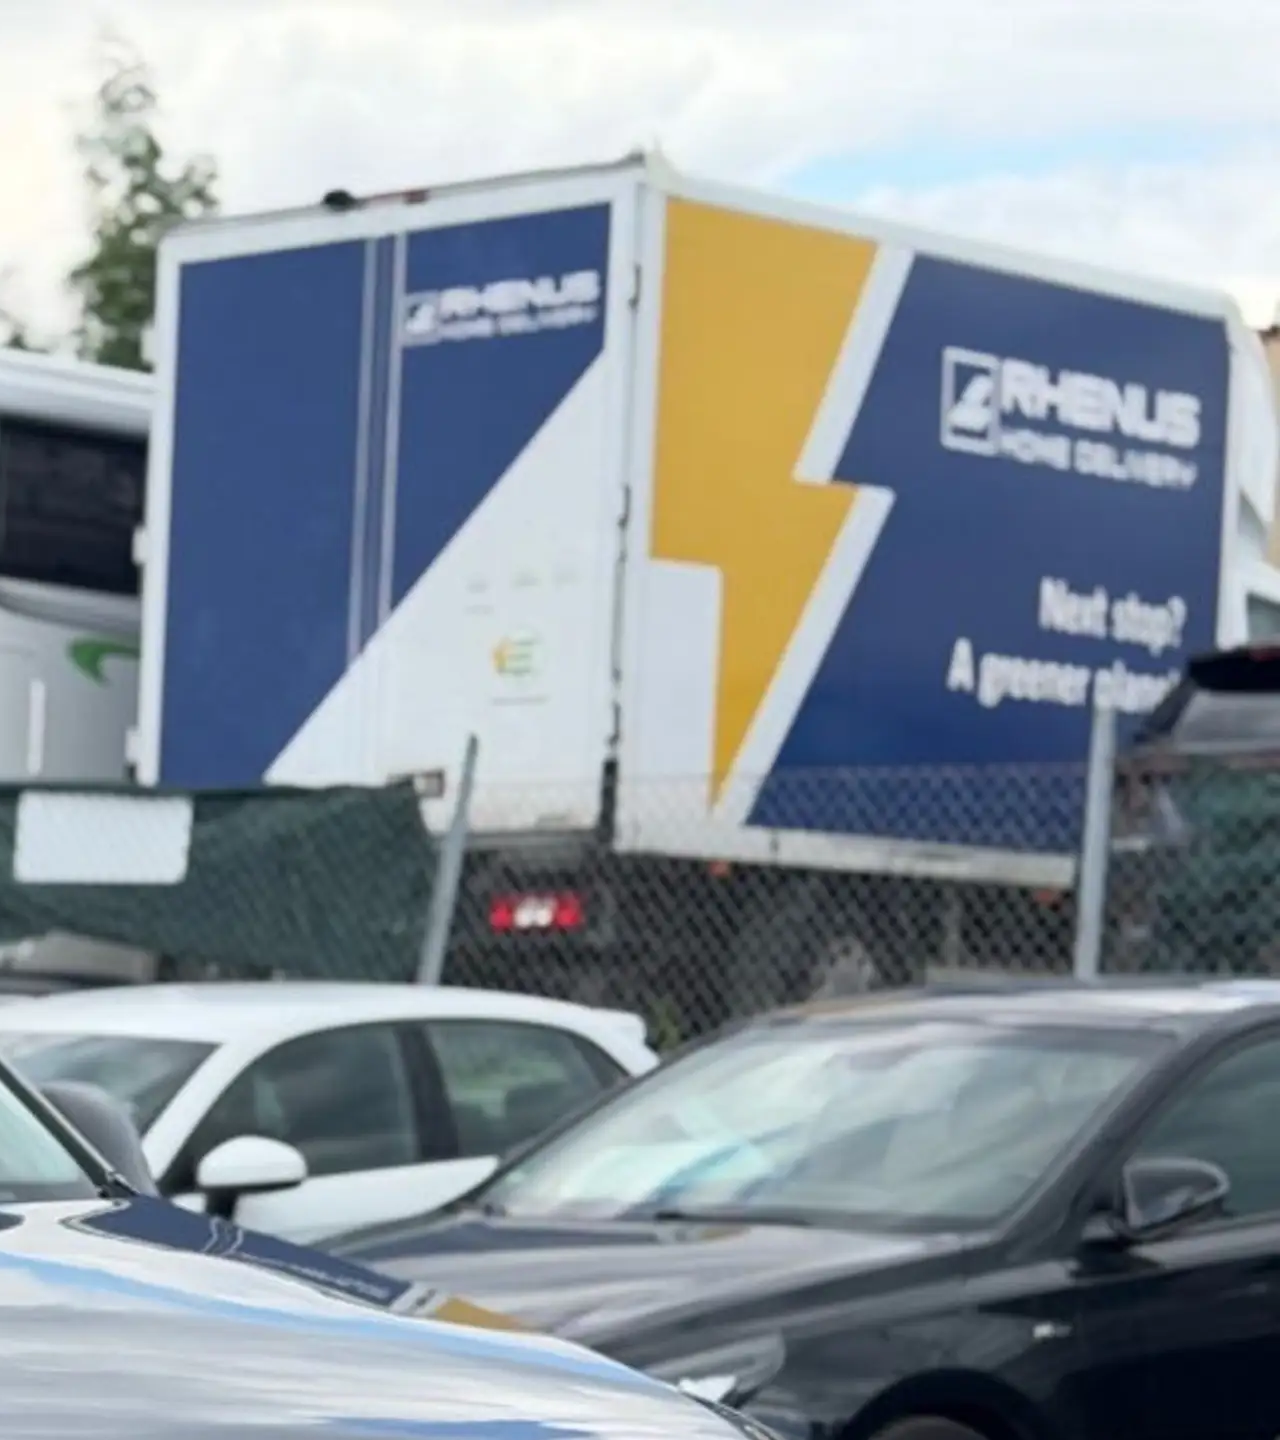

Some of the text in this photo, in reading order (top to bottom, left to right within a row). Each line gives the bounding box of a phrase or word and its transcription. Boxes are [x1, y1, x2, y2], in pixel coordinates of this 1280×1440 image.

[1000, 356, 1201, 449] RHENUS
[1038, 575, 1186, 658] Next stop?
[946, 635, 975, 693] A
[977, 652, 1090, 709] greener
